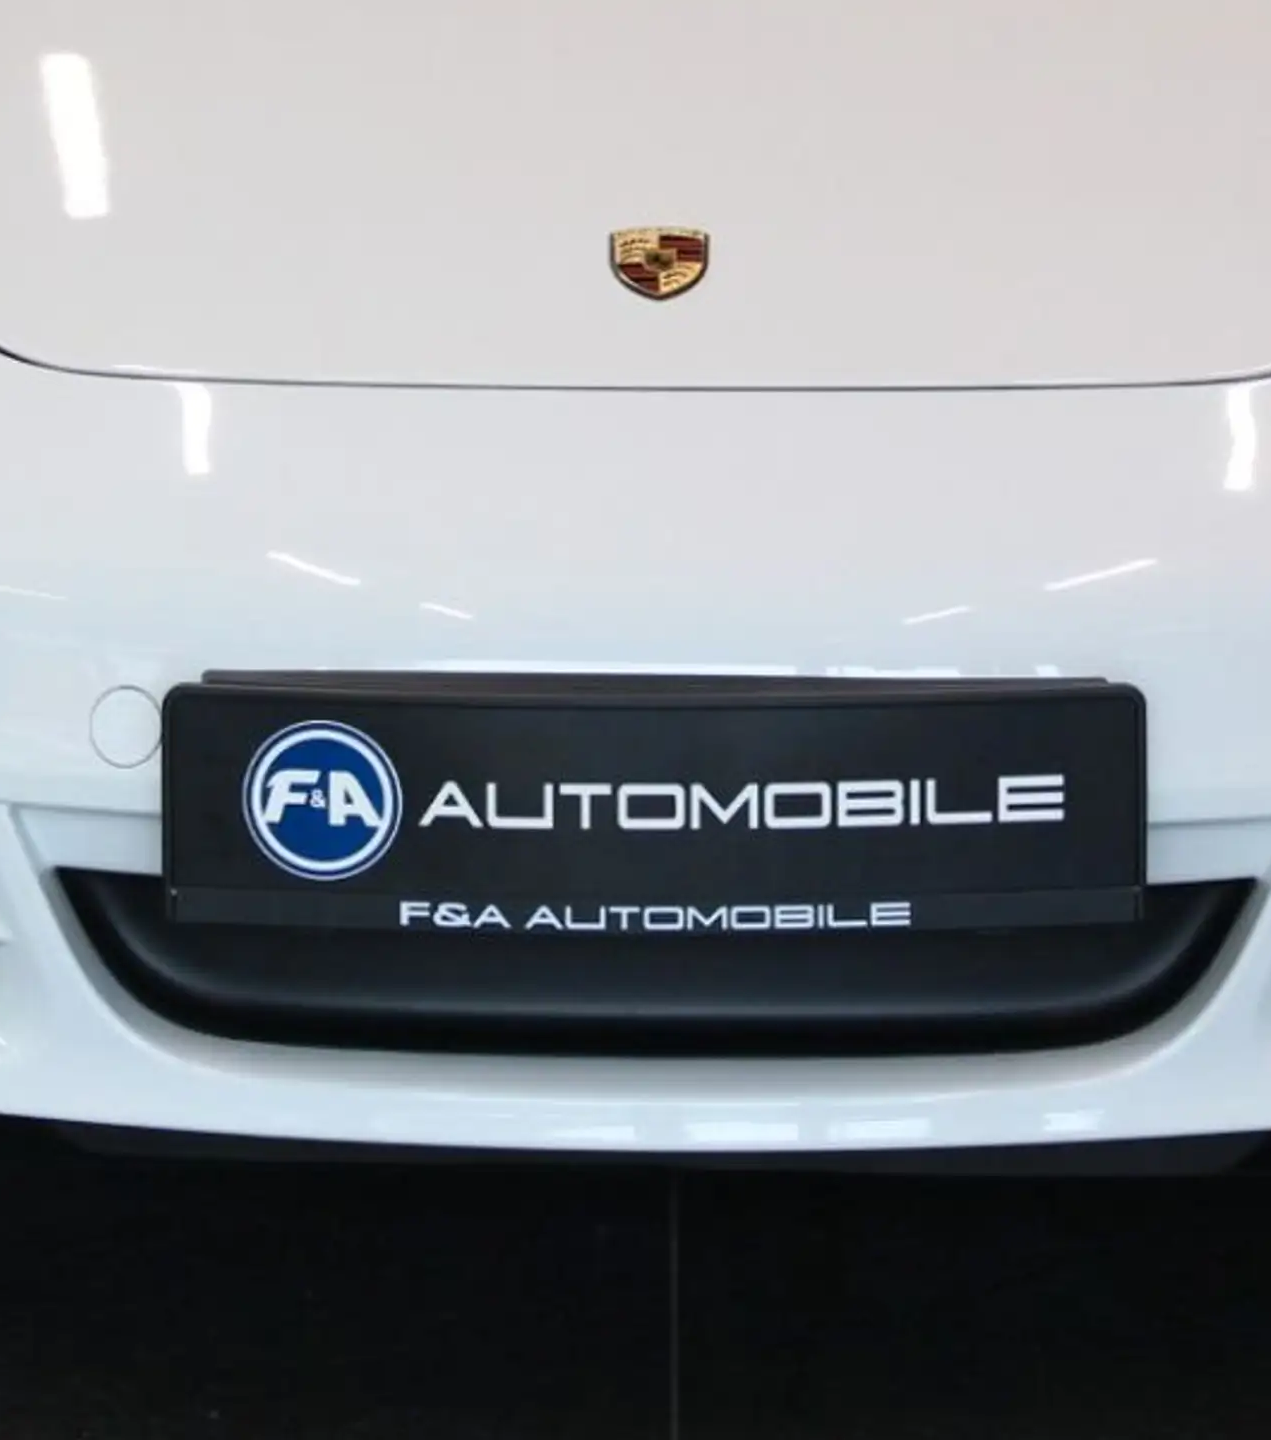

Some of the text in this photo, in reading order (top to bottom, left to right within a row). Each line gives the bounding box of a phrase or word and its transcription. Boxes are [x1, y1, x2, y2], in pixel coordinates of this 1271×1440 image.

[263, 769, 1065, 830] F&A AUTOMOBILE
[399, 900, 912, 931] F&A AUTOMOBILE
